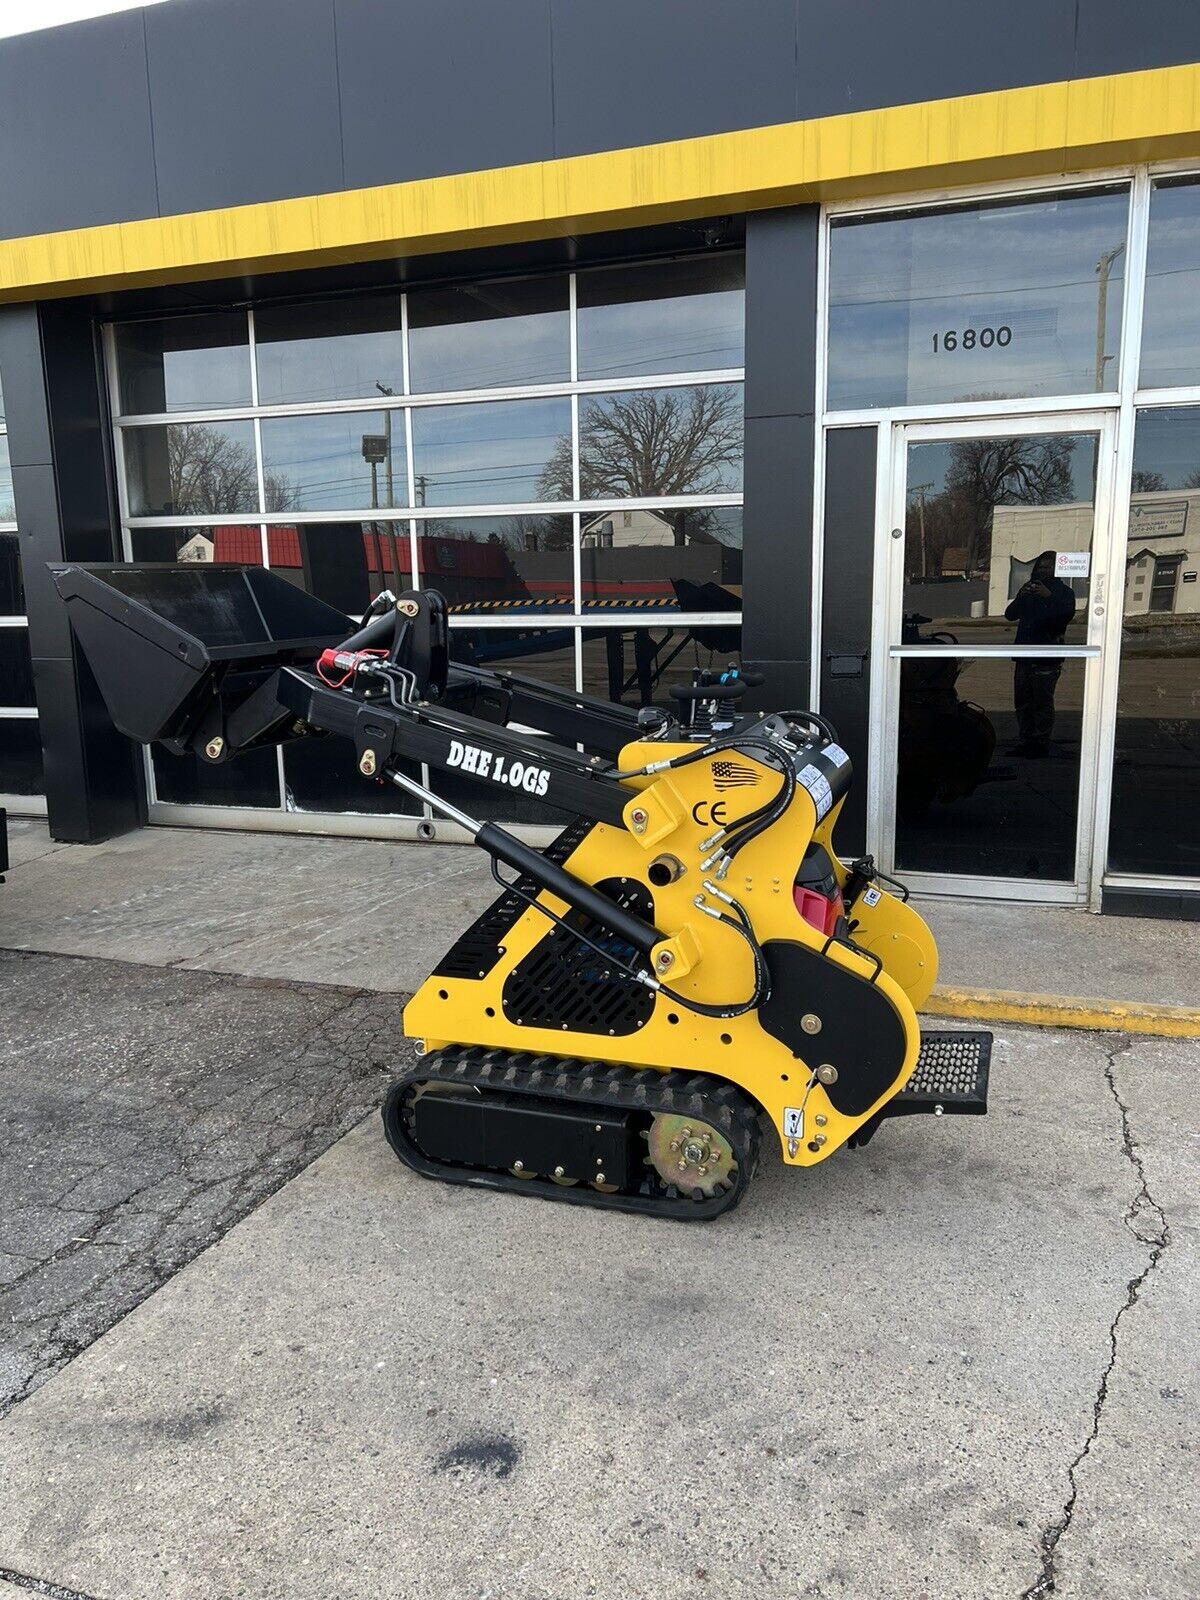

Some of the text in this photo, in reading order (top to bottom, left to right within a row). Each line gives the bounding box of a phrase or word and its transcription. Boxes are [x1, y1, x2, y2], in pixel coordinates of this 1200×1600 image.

[932, 326, 1012, 353] 16800
[446, 740, 493, 778] DHE
[692, 801, 728, 827] CE
